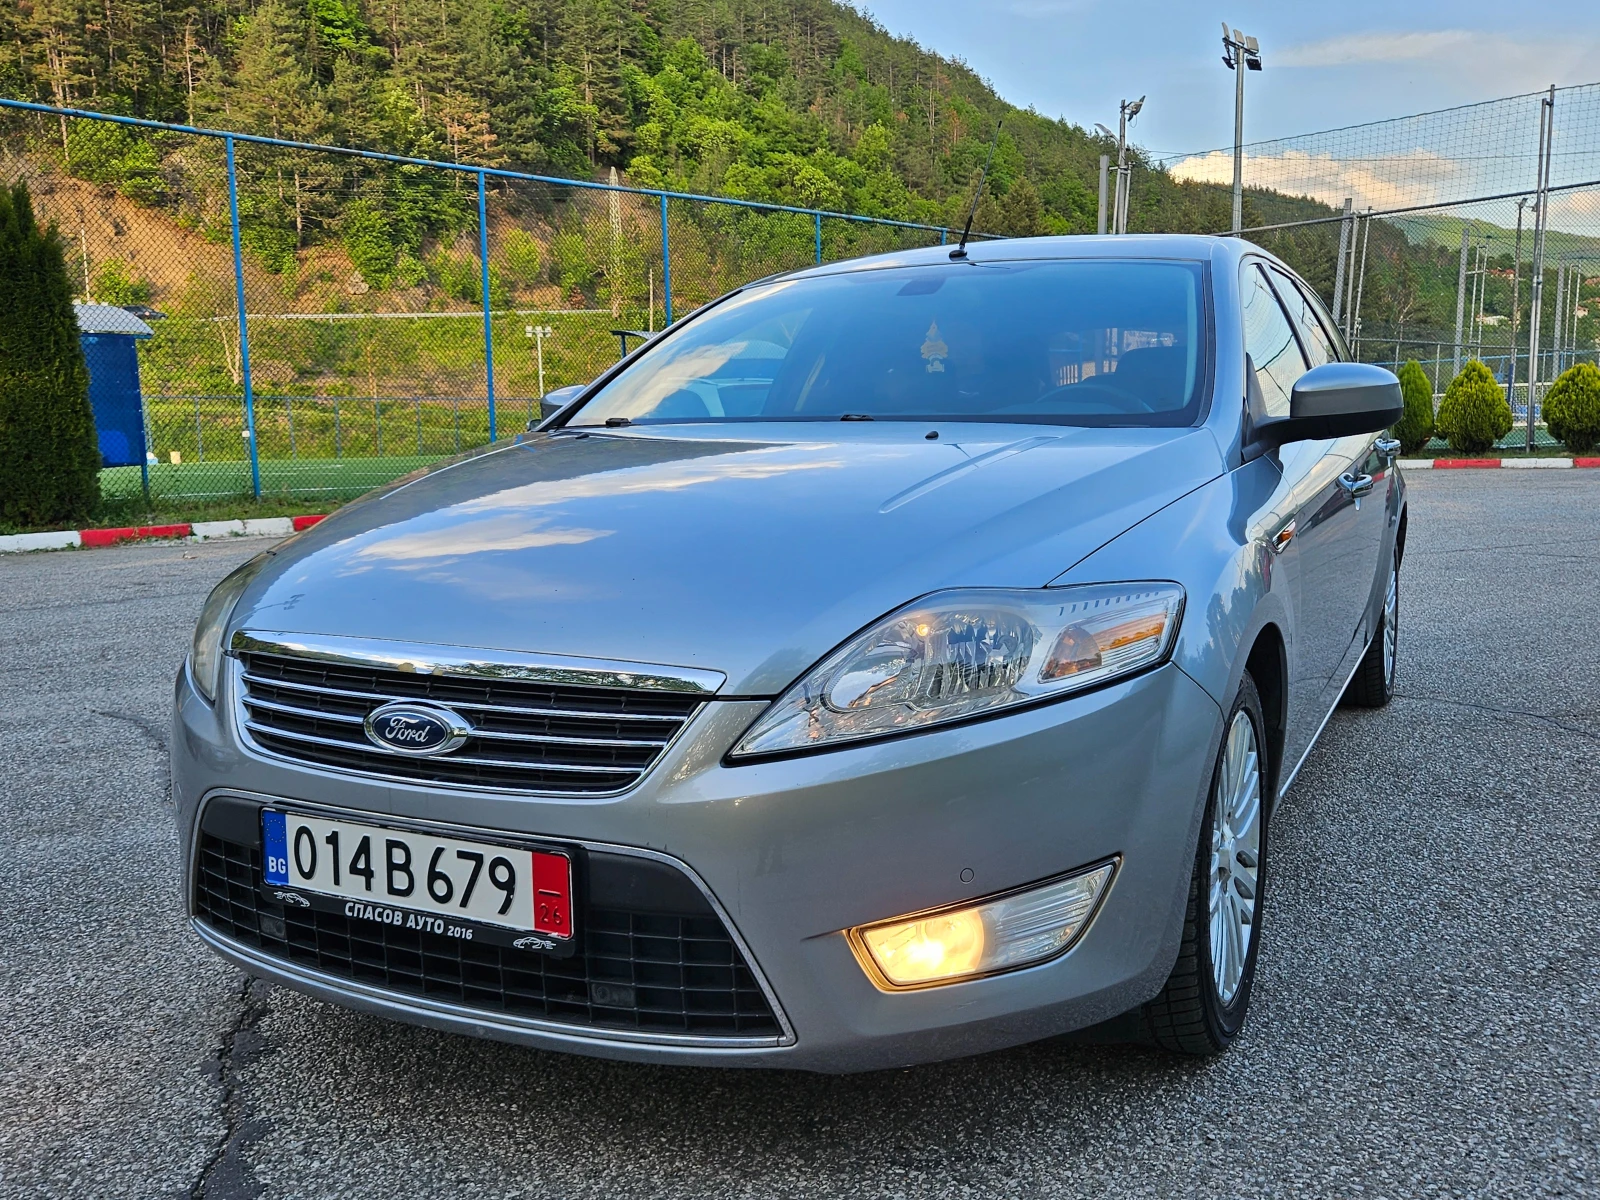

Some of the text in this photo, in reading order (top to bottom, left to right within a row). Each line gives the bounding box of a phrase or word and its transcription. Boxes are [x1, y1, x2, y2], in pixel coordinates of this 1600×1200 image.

[384, 716, 429, 743] Ford
[268, 856, 287, 874] BG
[344, 902, 473, 940] СПАСОВ АУТО 2016
[539, 903, 562, 925] 26
